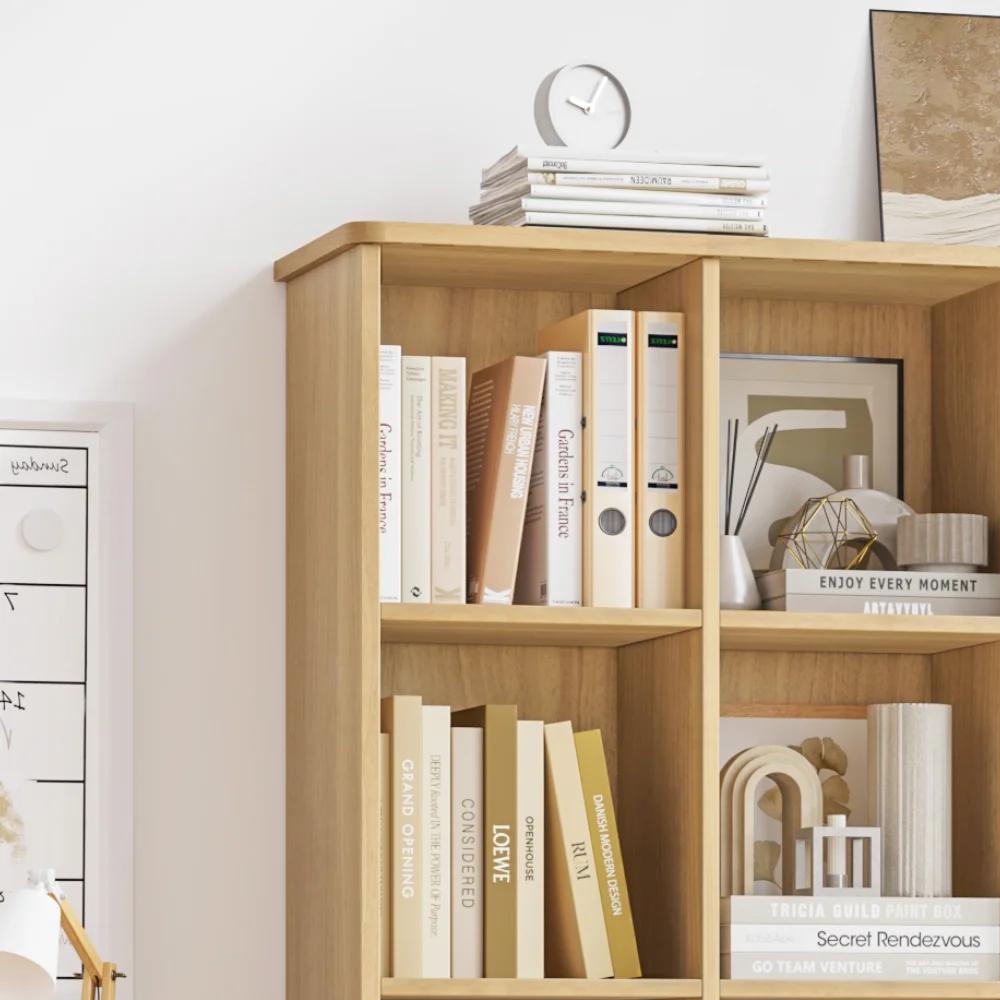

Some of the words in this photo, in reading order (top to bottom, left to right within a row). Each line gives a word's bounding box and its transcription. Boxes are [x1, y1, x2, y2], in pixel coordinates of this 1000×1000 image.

[438, 368, 458, 430] MAKING
[438, 434, 458, 450] IT
[556, 428, 575, 478] Gardens
[557, 482, 575, 494] in
[557, 498, 575, 540] France
[819, 576, 864, 590] ENJOY
[869, 577, 913, 591] EVERY
[919, 578, 978, 593] MOMENT
[401, 759, 415, 817] GRAND
[592, 794, 608, 832] DANISH
[401, 824, 415, 899] OPENING
[461, 798, 476, 909] CONSIDERED
[492, 824, 511, 883] LOEWE
[525, 816, 535, 882] OPENHOUSE
[571, 841, 592, 880] RUM
[599, 834, 616, 878] MODERN
[606, 879, 623, 916] DESIGN
[769, 903, 825, 919] TRICIA
[832, 903, 880, 919] GUILD
[886, 904, 928, 919] PAINT
[934, 904, 963, 919] BOX
[816, 931, 872, 948] Secret
[877, 931, 981, 948] Rendezvous
[752, 960, 773, 974] GO
[775, 960, 815, 974] TEAM
[820, 960, 883, 974] VENTURE
